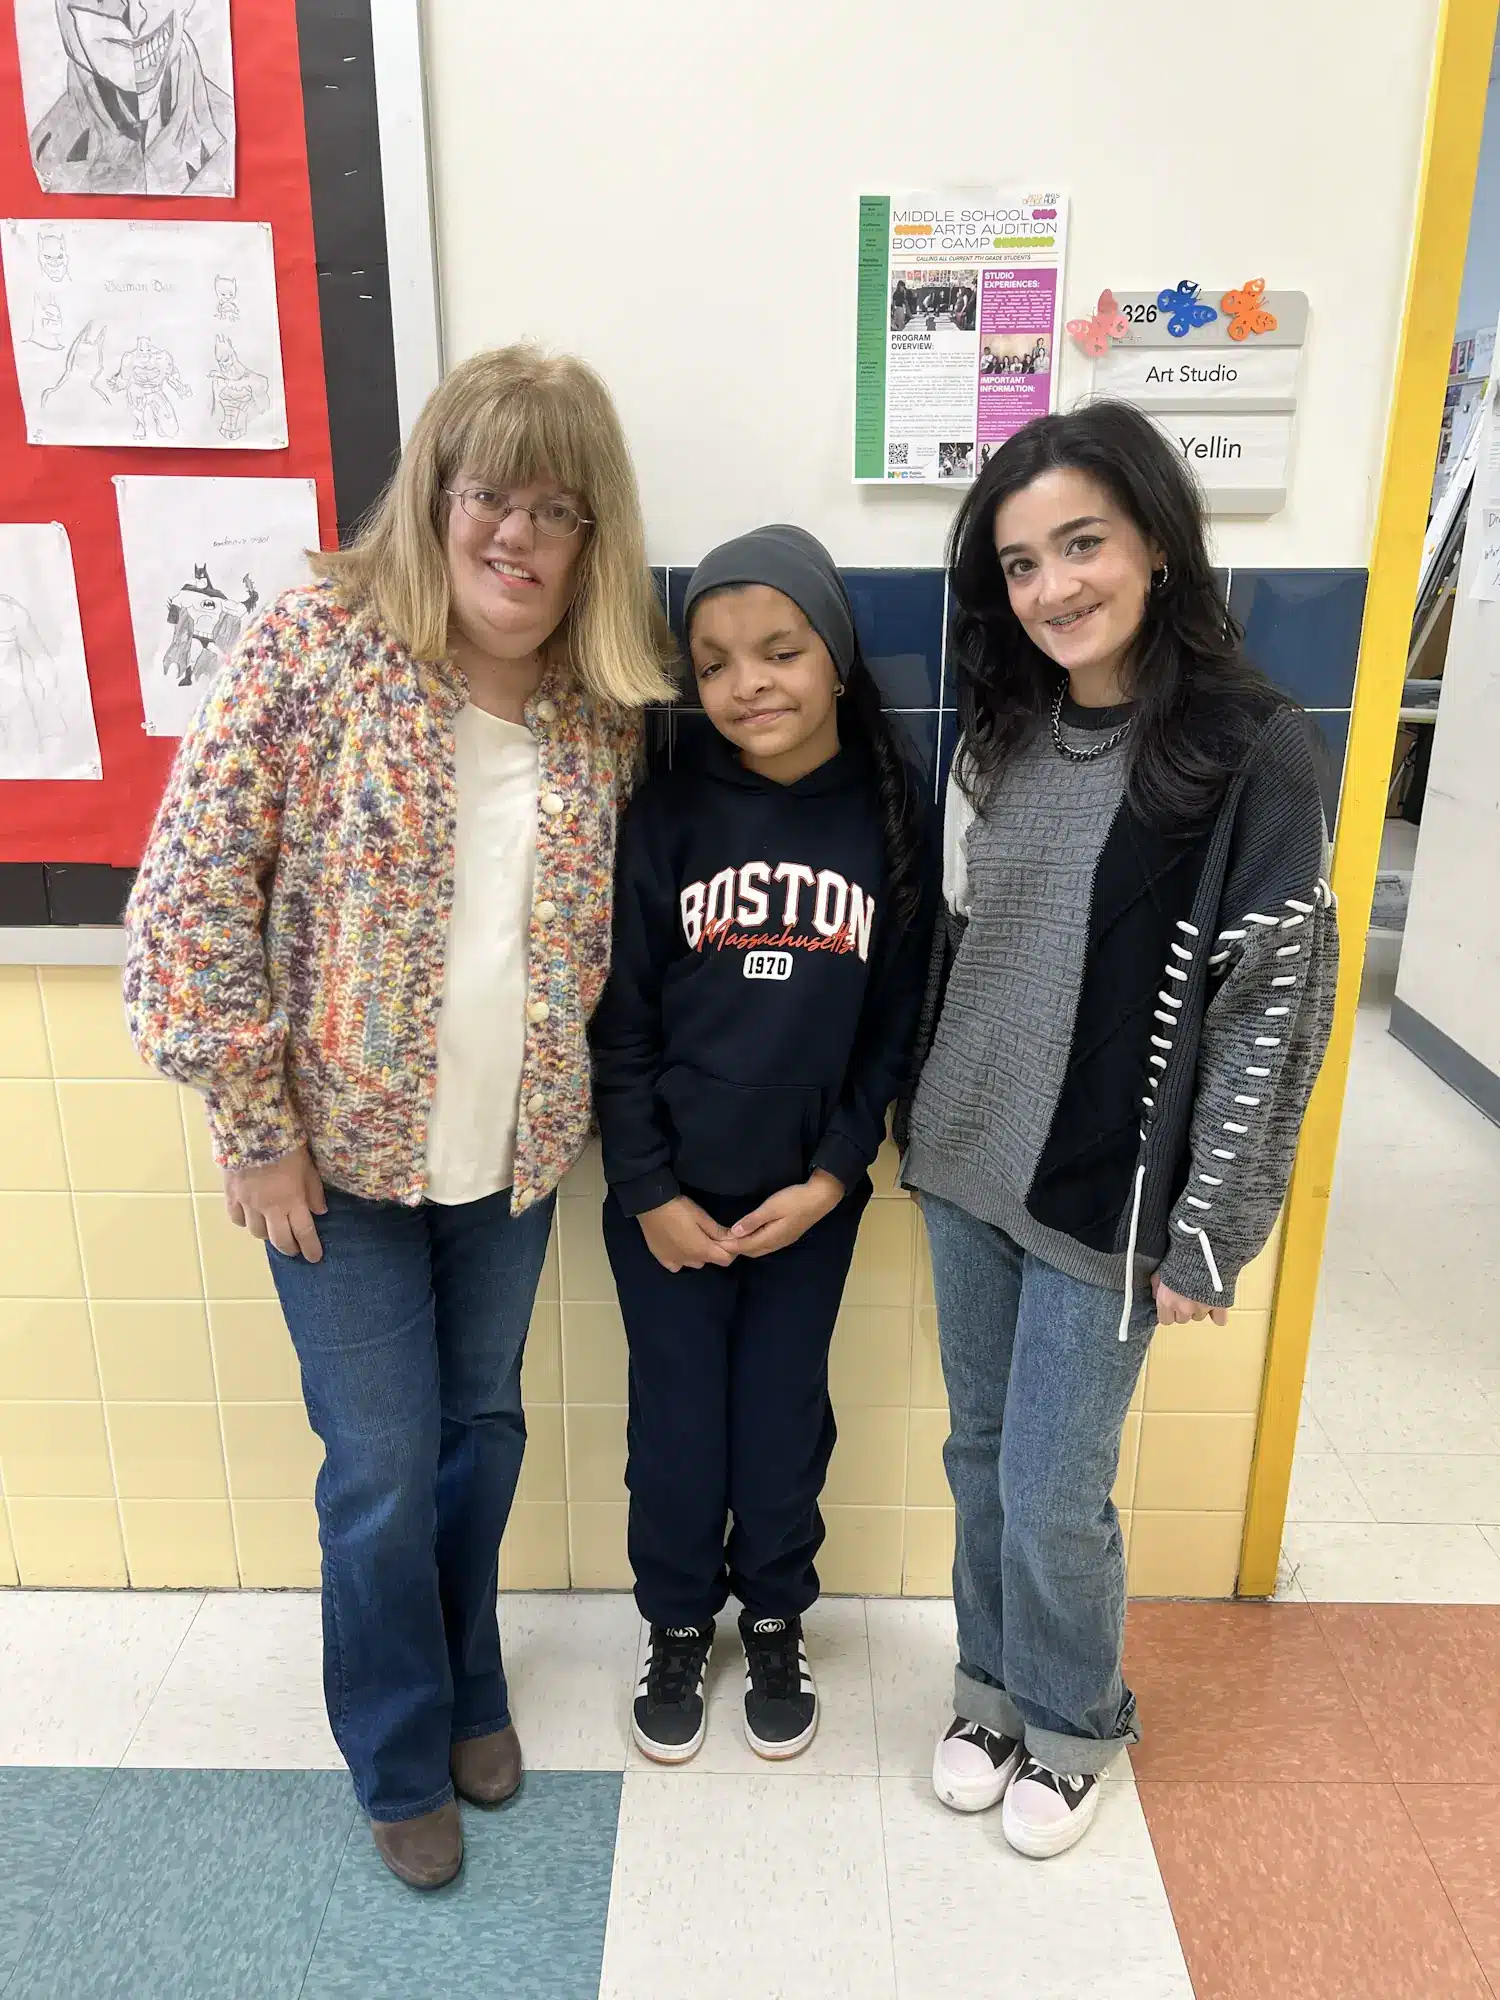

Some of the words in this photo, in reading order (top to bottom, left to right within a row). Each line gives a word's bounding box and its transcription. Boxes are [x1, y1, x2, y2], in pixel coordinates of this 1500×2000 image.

[893, 210, 955, 222] MIDDLE
[960, 209, 1030, 222] SCHOOL
[933, 223, 976, 235] ARTS
[981, 222, 1058, 235] AUDITION
[892, 237, 937, 249] BOOT
[941, 237, 991, 249] CAMP
[984, 271, 1015, 280] STUDIO
[984, 280, 1040, 289] EXPERIENCES:
[1121, 304, 1158, 323] 326
[891, 334, 931, 342] PROGRAM
[891, 342, 935, 350] OVERVIEW:
[1145, 365, 1174, 383] Art
[1179, 363, 1238, 383] Studio
[980, 376, 1026, 384] IMPORTANT
[980, 384, 1036, 393] INFORMATION:
[1178, 435, 1242, 459] Yellin
[680, 860, 876, 964] BOSTON
[696, 917, 856, 953] Massachusetts
[748, 956, 788, 976] 1970
